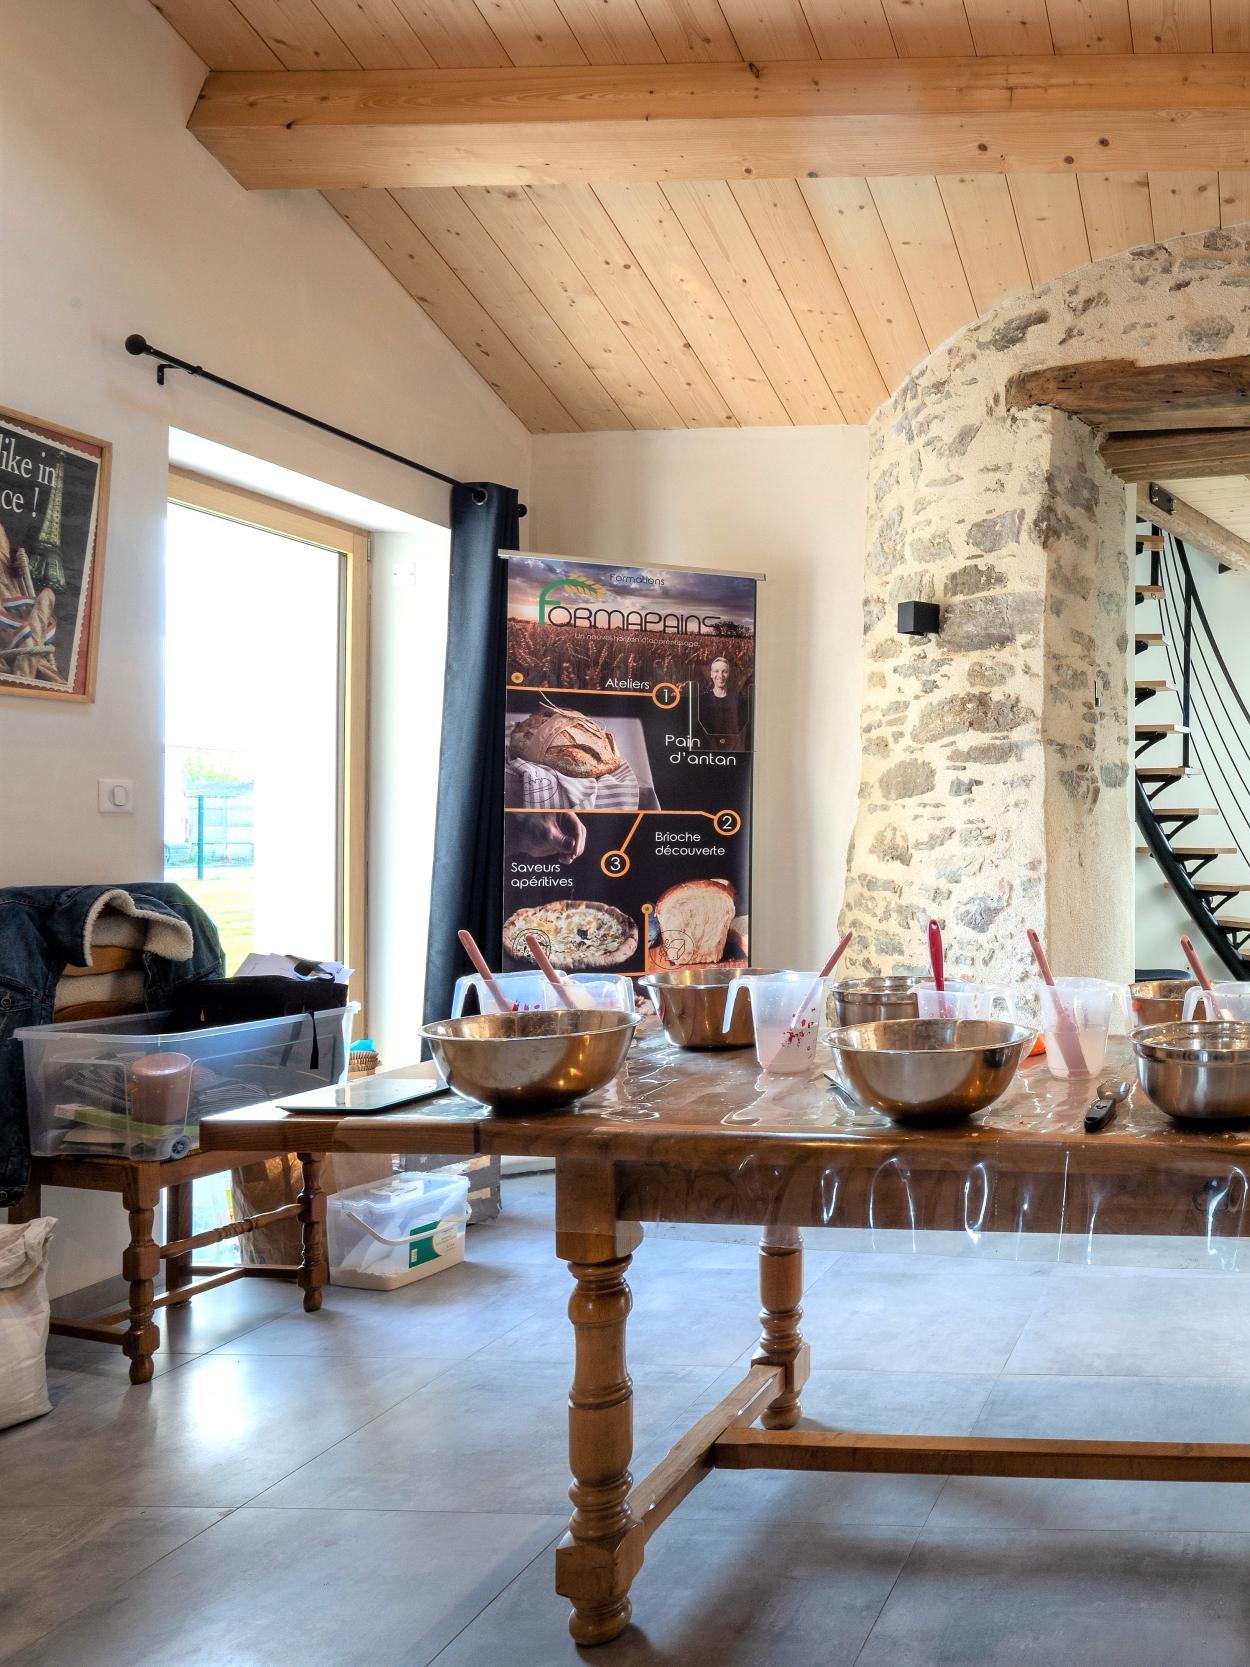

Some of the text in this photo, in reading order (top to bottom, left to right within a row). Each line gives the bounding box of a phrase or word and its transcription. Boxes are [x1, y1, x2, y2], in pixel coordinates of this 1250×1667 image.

[37, 451, 56, 487] in
[32, 487, 39, 518] !
[610, 573, 665, 586] Formations
[604, 678, 650, 690] Ateliers
[663, 688, 668, 703] 1
[665, 734, 700, 747] Pain
[669, 751, 736, 766] d'antan
[722, 816, 733, 830] 2
[655, 831, 701, 842] Brioche
[655, 845, 726, 856] découverte
[511, 862, 561, 873] Saveurs
[610, 856, 621, 871] 3
[510, 876, 573, 889] apéritives
